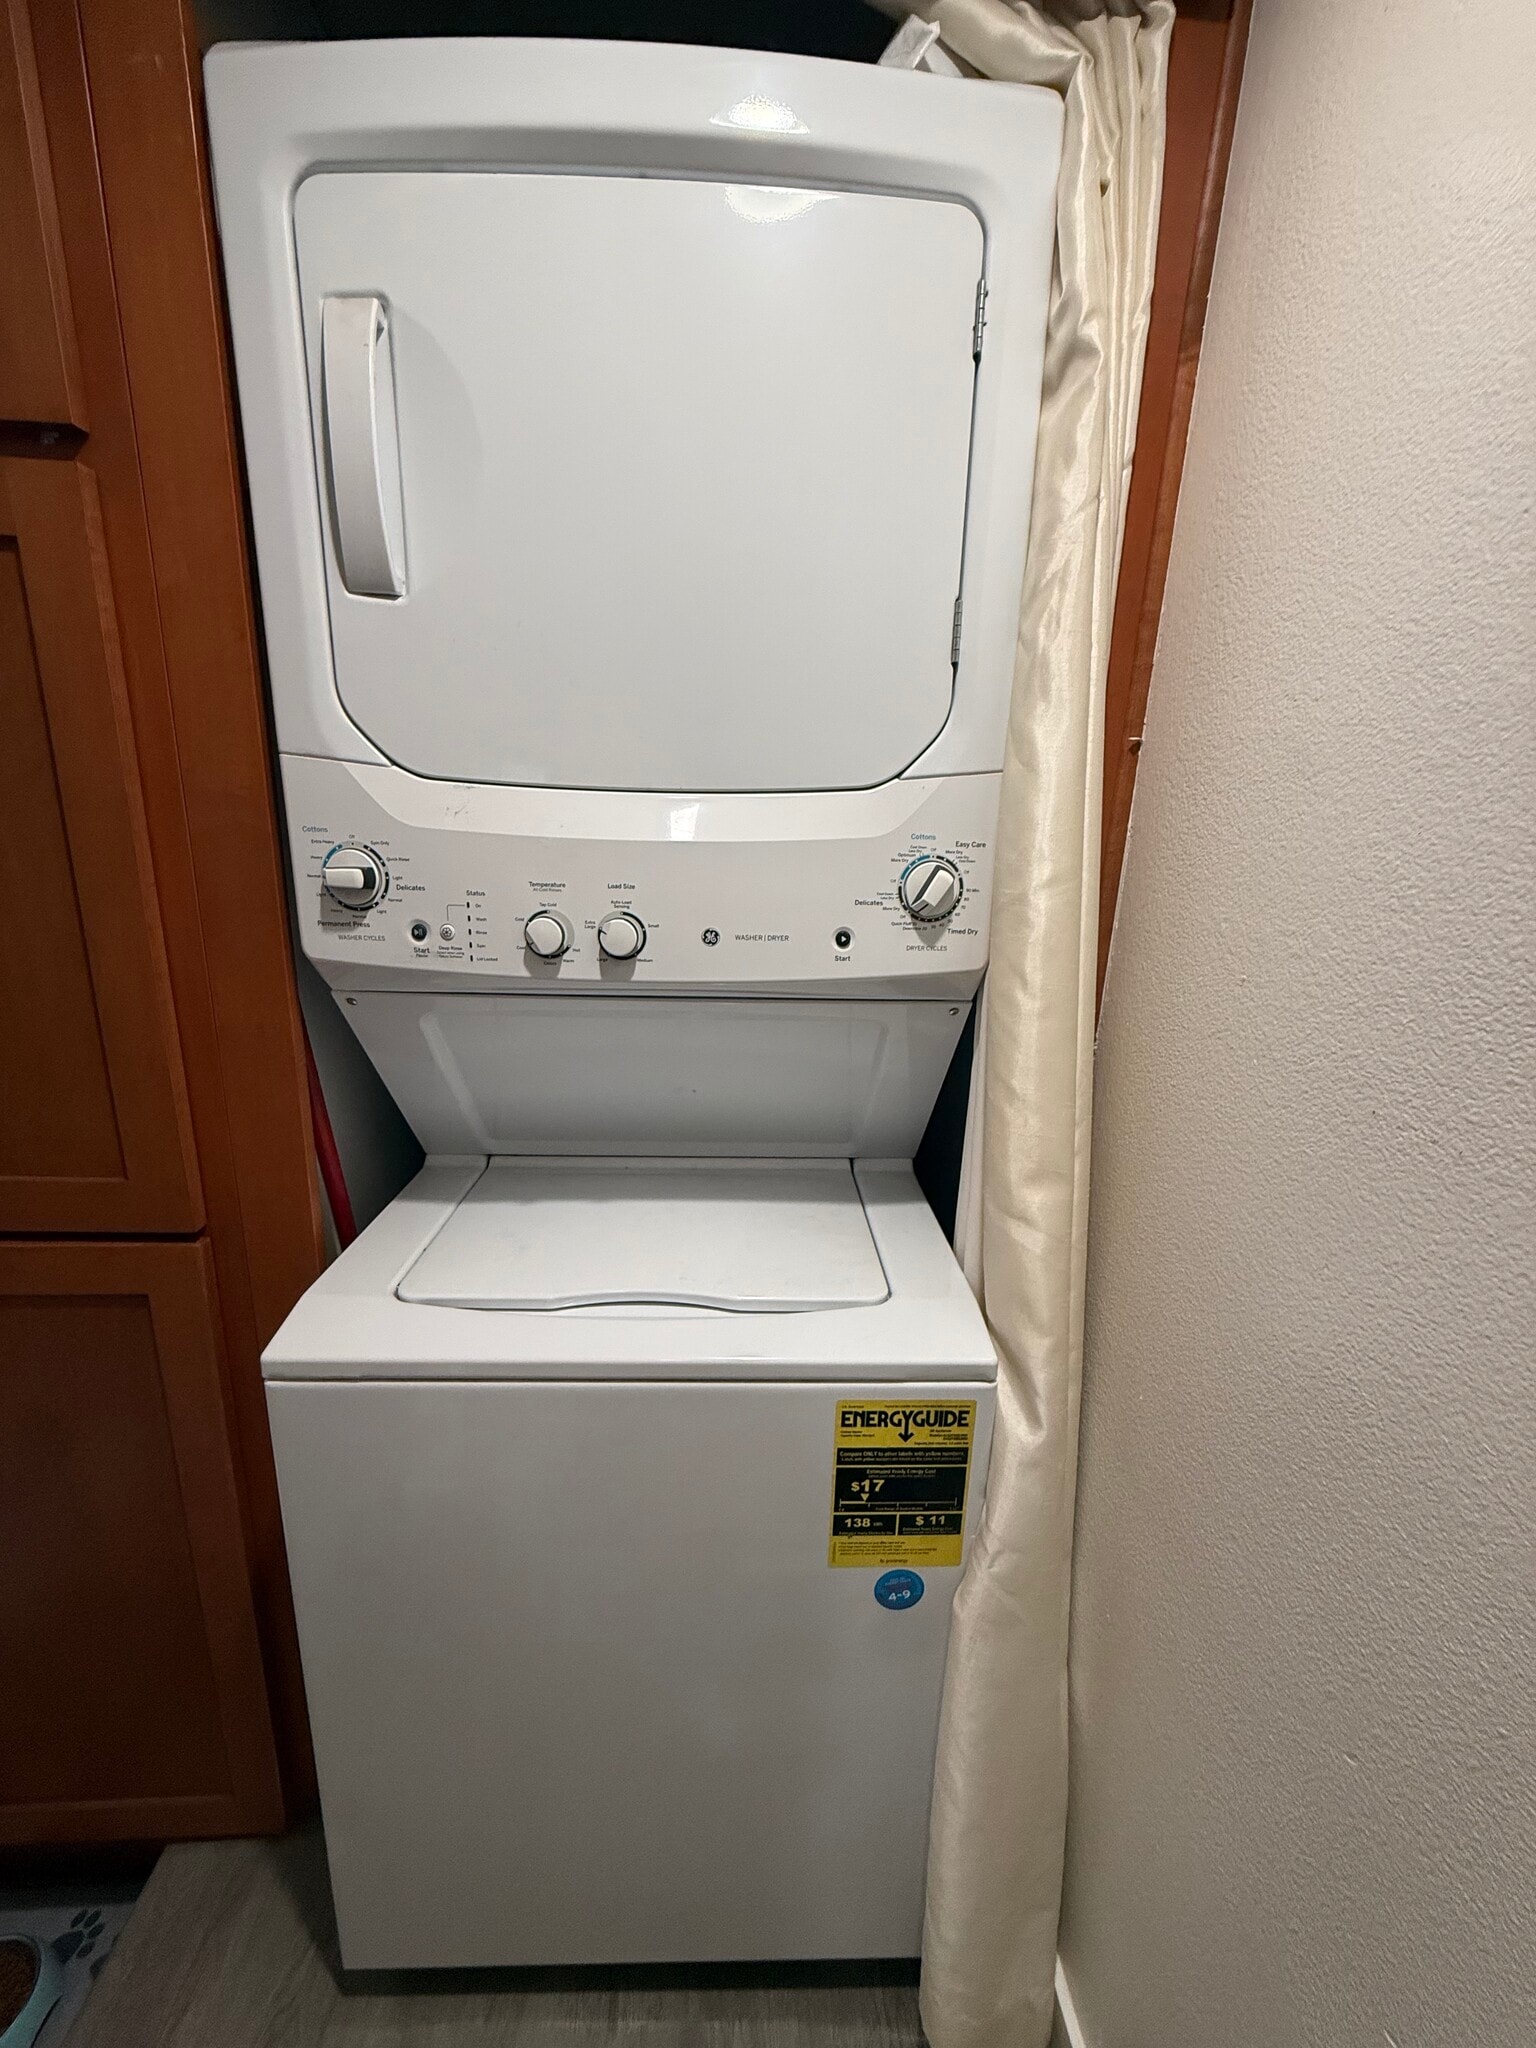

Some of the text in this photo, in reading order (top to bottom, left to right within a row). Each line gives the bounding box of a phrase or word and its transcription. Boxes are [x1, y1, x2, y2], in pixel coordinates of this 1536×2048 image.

[910, 833, 937, 841] Cottons
[955, 841, 970, 849] Easy
[528, 881, 566, 889] Temperature
[854, 899, 884, 907] Delicates
[841, 1410, 971, 1428] ENERGYGUIDE
[851, 1479, 885, 1493] $17
[844, 1518, 871, 1528] 138
[915, 1515, 945, 1526] $ 11
[888, 1589, 911, 1601] 4-9
